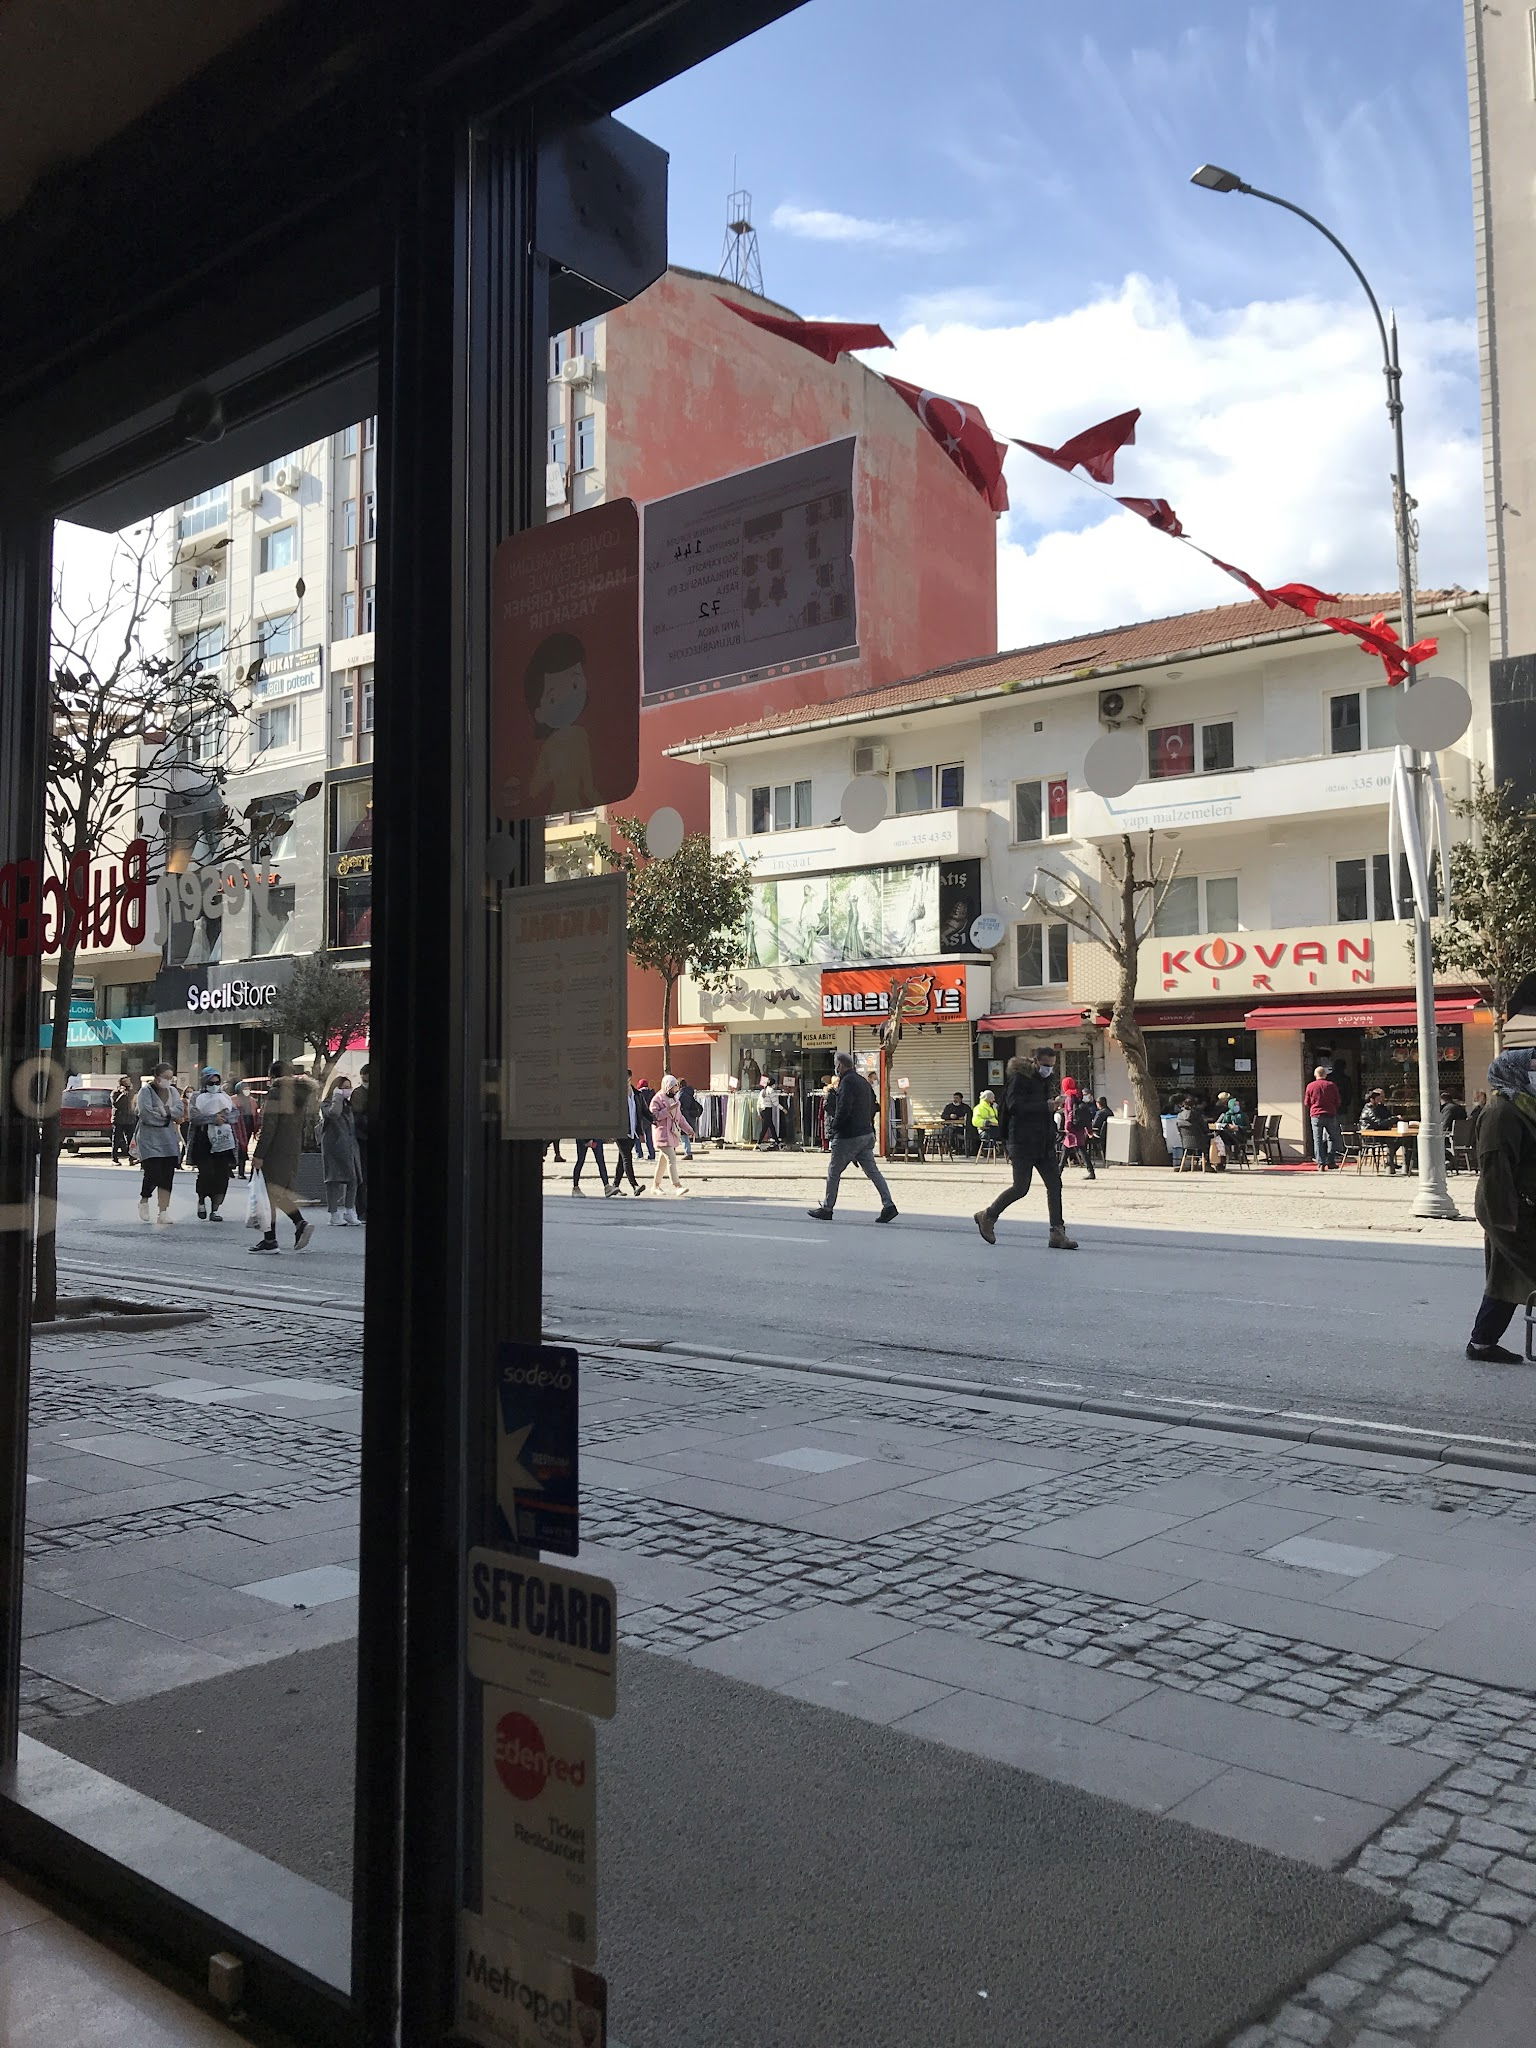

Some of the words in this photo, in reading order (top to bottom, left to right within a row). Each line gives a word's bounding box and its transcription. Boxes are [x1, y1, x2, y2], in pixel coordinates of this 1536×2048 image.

[287, 671, 315, 692] patent
[1123, 814, 1150, 829] yapı
[1153, 803, 1233, 823] malzemeleri
[1163, 937, 1373, 975] KOVAN
[1163, 969, 1374, 993] FIRIN
[187, 980, 277, 1011] SecilStore
[823, 991, 890, 1014] BURGER
[503, 1363, 572, 1389] sodexo
[472, 1560, 611, 1656] SETCARD
[495, 1732, 587, 1788] Edenred
[465, 1949, 573, 2030] Metropol
